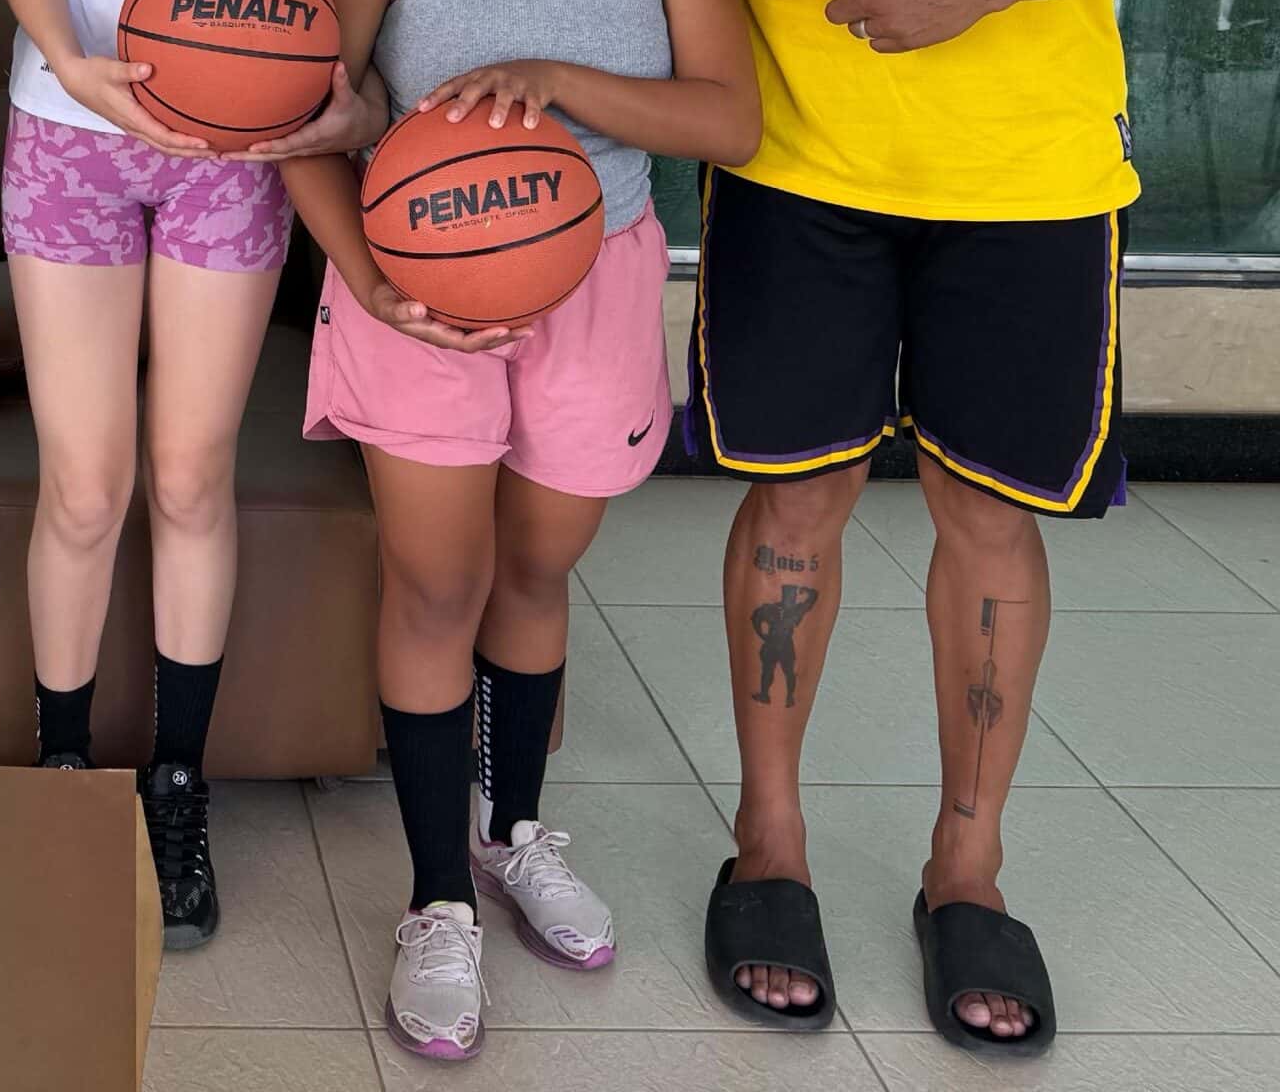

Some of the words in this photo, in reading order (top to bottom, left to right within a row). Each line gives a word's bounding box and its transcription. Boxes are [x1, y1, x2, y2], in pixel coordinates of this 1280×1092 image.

[408, 171, 562, 231] PENALTY
[451, 214, 502, 230] BASQUETE
[504, 207, 540, 220] OFICIAL
